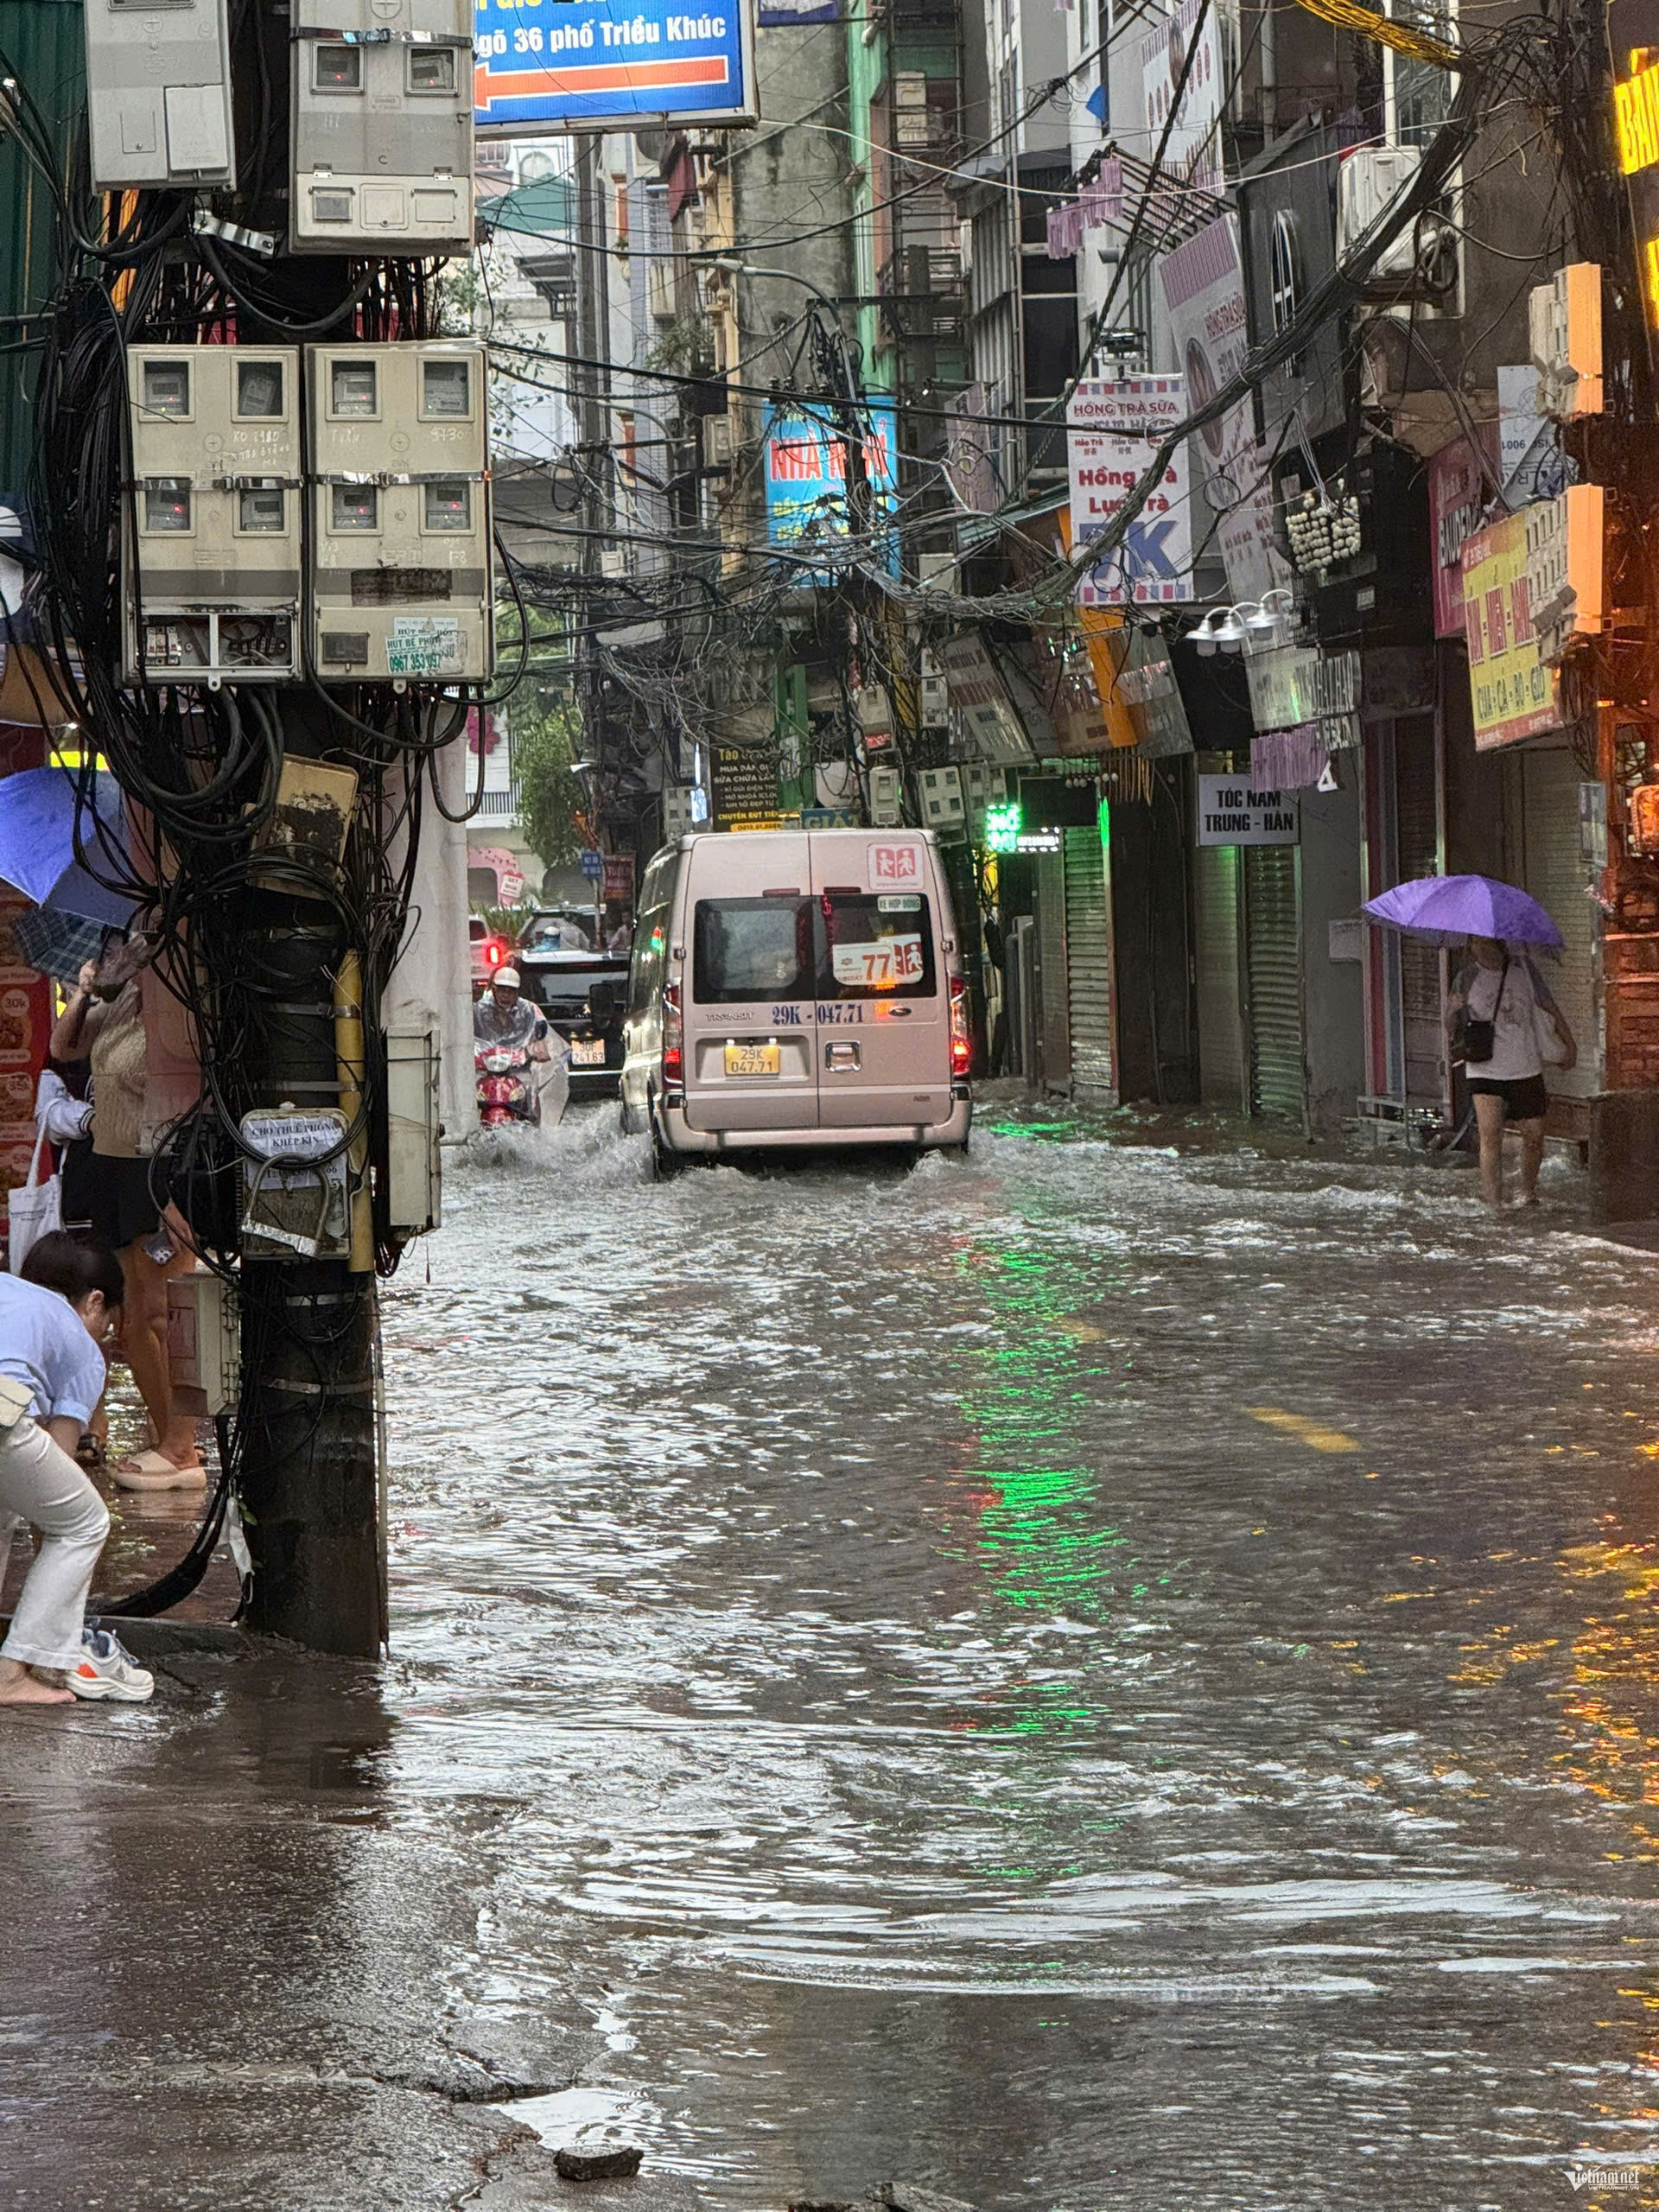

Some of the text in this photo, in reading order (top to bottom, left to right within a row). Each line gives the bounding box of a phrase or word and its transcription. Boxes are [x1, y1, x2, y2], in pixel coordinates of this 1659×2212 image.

[474, 14, 726, 58] gõ 36 phố Triều Khúc
[1117, 400, 1147, 414] TRÀ
[1149, 399, 1177, 413] SỮA
[1078, 466, 1136, 490] Hồng
[1216, 787, 1281, 809] TÓC NAM
[1204, 813, 1251, 832] TRUNG
[1263, 810, 1294, 831] HÀN
[861, 954, 891, 981] 77
[705, 1012, 754, 1022] TRANSIT
[772, 1006, 803, 1025] 29K
[817, 1004, 864, 1024] 047.71
[741, 1048, 764, 1060] 29K
[731, 1061, 773, 1073] 047.71
[251, 1127, 273, 1136] CHO
[276, 1124, 304, 1135] THUÊ
